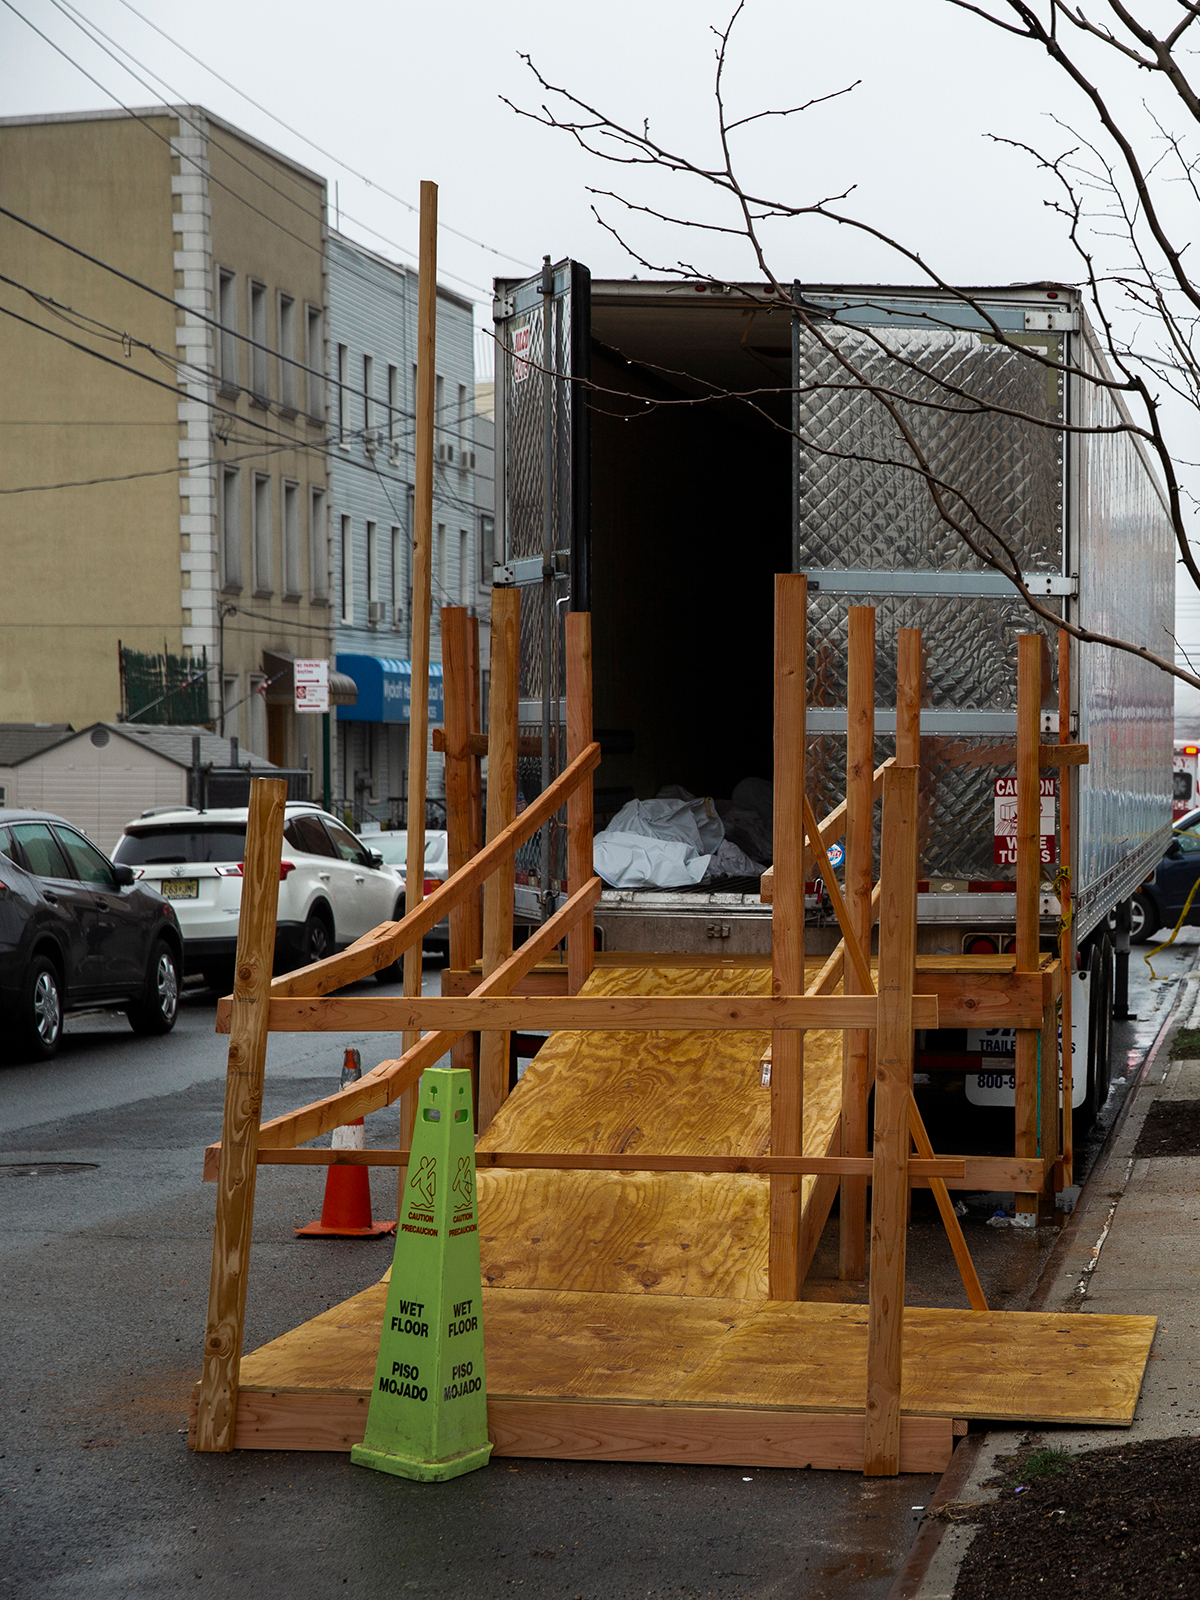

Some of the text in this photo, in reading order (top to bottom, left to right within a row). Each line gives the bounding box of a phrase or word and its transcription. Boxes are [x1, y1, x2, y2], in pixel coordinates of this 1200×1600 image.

[1006, 837, 1047, 850] WE
[999, 850, 1051, 864] TUS
[408, 1212, 434, 1223] CAUTION
[453, 1212, 473, 1224] CAUTION
[401, 1223, 439, 1237] PRECAUCION
[448, 1223, 478, 1237] PRECAUCION
[399, 1299, 425, 1318] WET
[453, 1299, 473, 1318] WET
[391, 1316, 429, 1338] FLOOR
[448, 1316, 478, 1338] FLOOR
[392, 1361, 419, 1381] PISO
[452, 1361, 473, 1380] PISO
[379, 1377, 428, 1402] MOJADO
[443, 1377, 482, 1402] MOJADO
